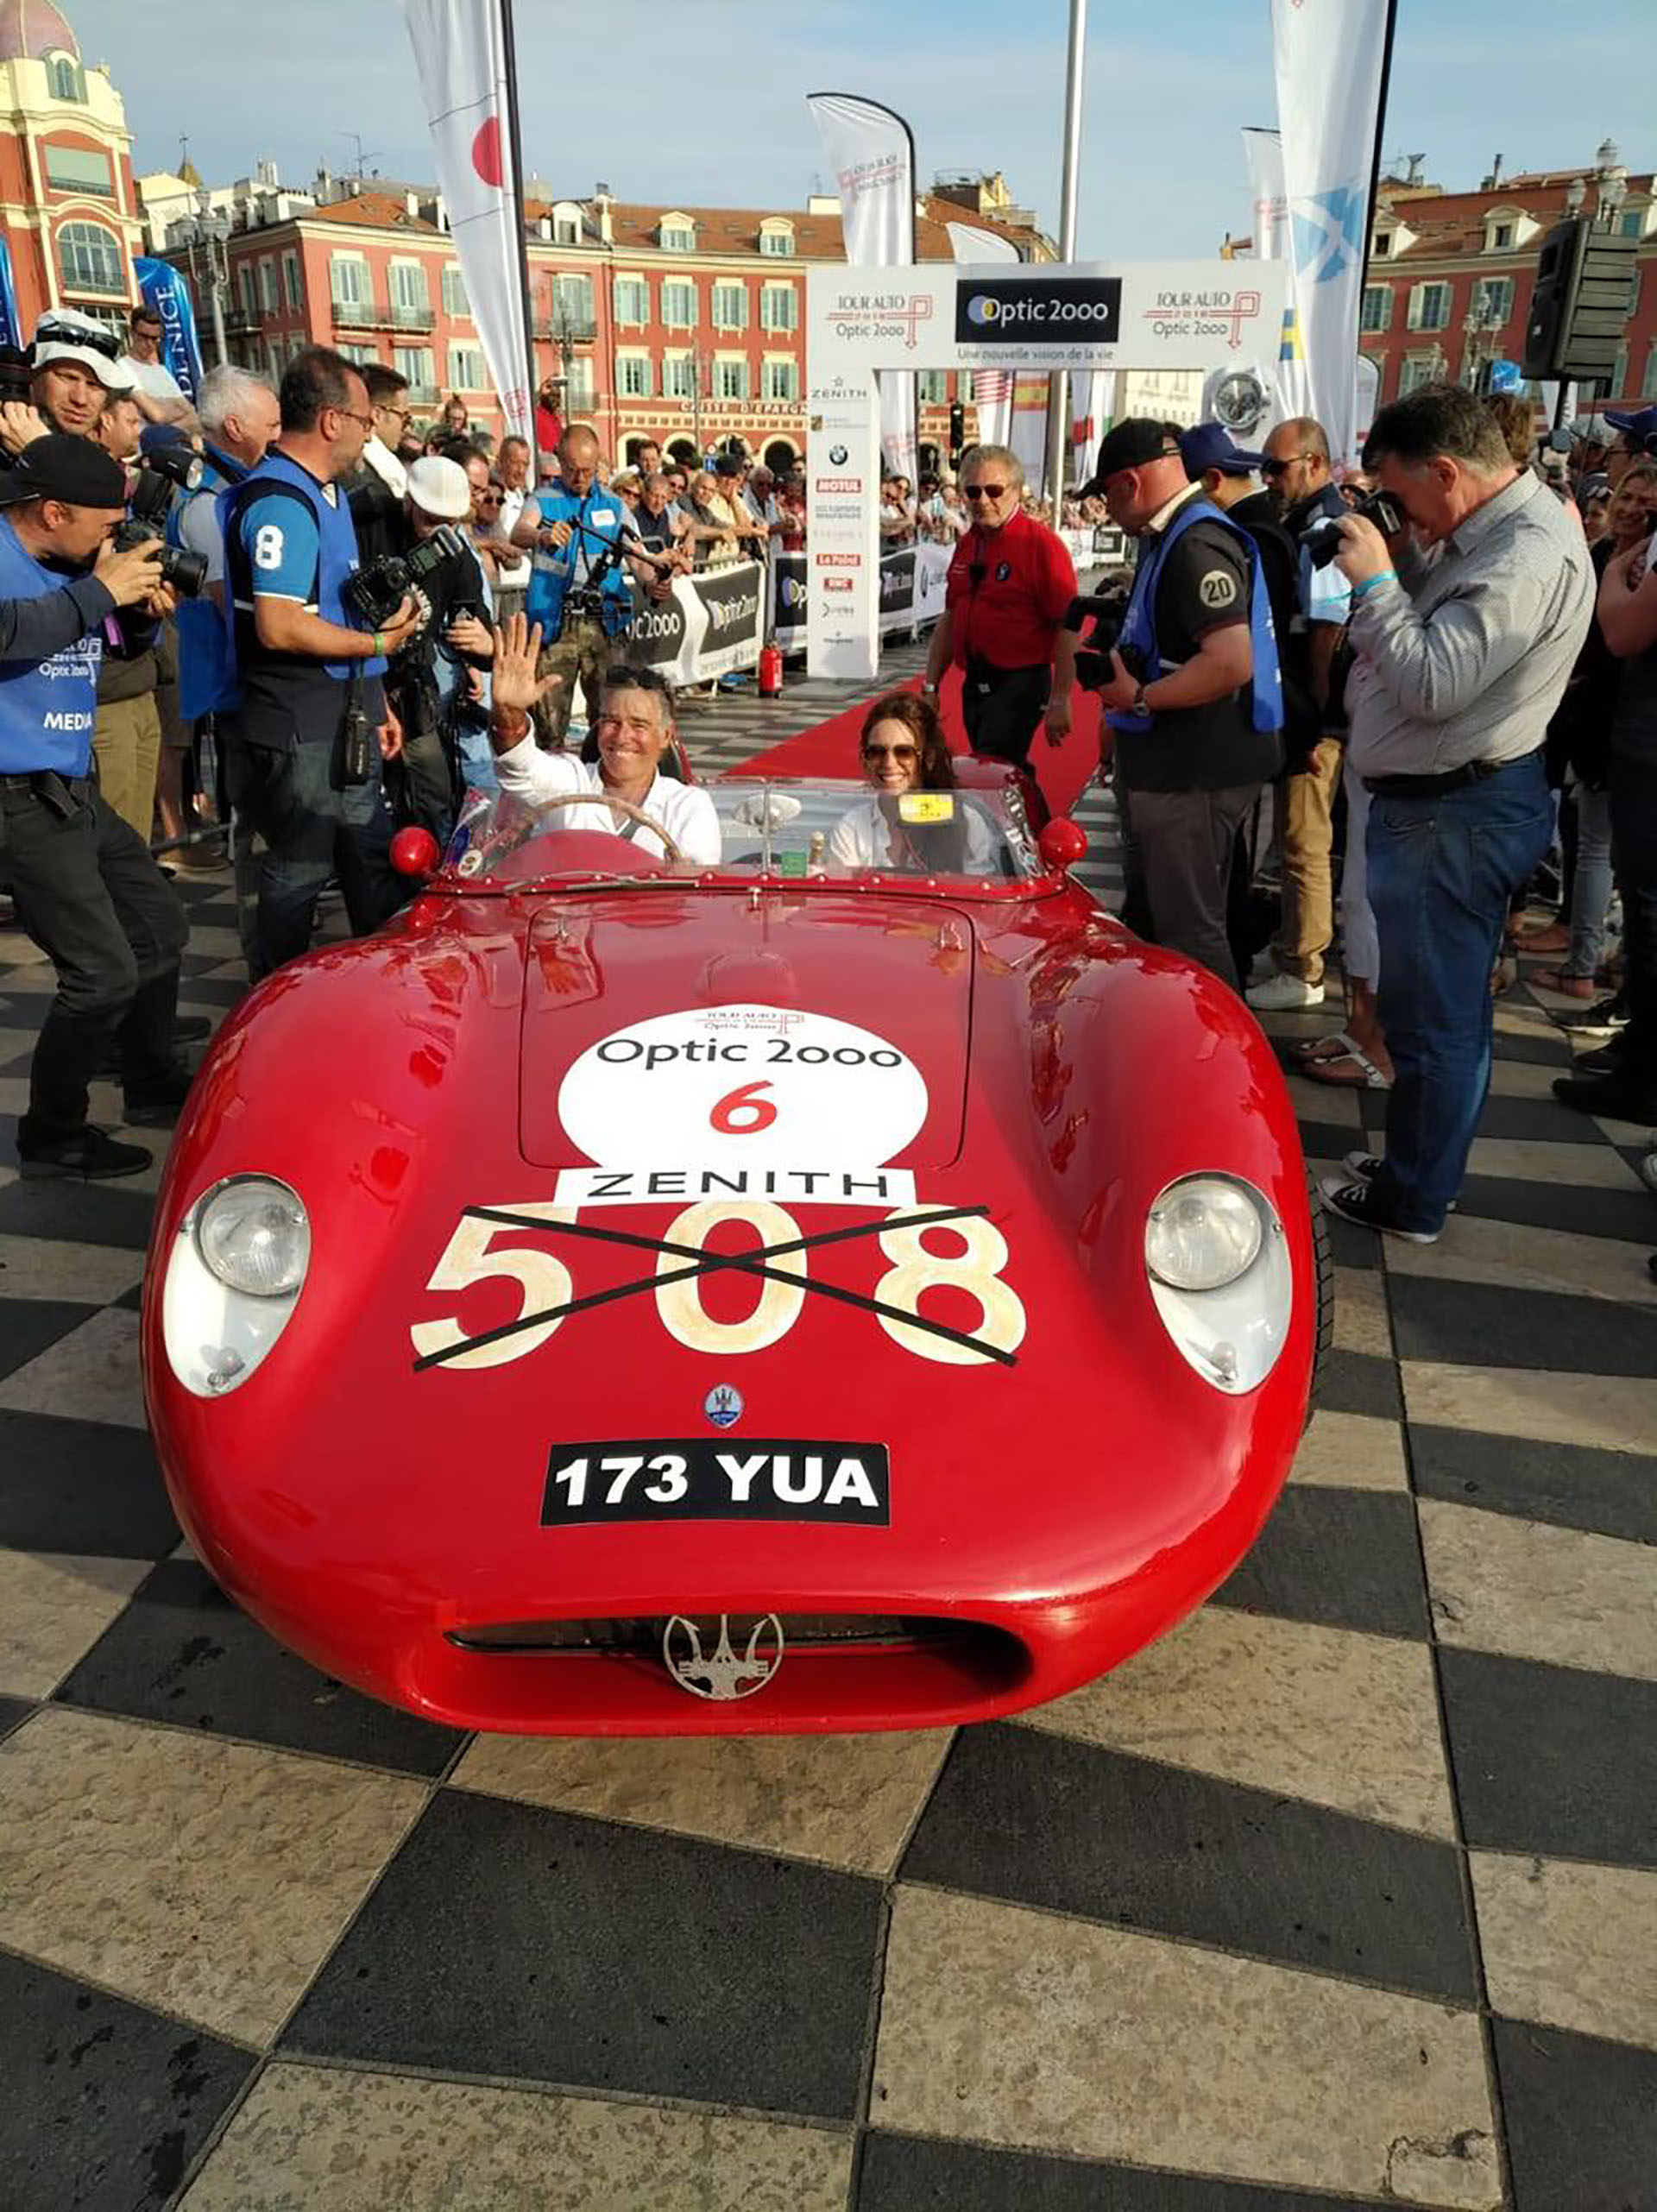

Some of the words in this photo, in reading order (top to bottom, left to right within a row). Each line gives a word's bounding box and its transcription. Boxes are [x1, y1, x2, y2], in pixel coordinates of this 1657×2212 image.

[154, 285, 186, 353] NICE
[981, 298, 1046, 328] Optic
[1049, 299, 1109, 320] 2000
[835, 322, 870, 340] Optic
[873, 323, 905, 337] 2000
[1153, 320, 1190, 338] Optic
[1194, 321, 1228, 335] 2000
[957, 349, 980, 360] Une
[982, 348, 1029, 360] nouvelle
[1033, 348, 1064, 360] vision
[1067, 348, 1079, 360] de
[1084, 348, 1093, 359] la
[812, 389, 866, 398] ZENITH
[817, 481, 859, 492] MOTUL
[255, 525, 284, 570] 8
[1204, 577, 1232, 602] 20
[644, 611, 681, 639] 2000
[596, 1038, 748, 1070] Optic
[766, 1039, 903, 1068] 2000
[709, 1081, 778, 1135] 6
[587, 1170, 888, 1198] ZENITH
[410, 1201, 1027, 1370] 508
[555, 1454, 689, 1507] 173
[715, 1454, 880, 1508] YUA
